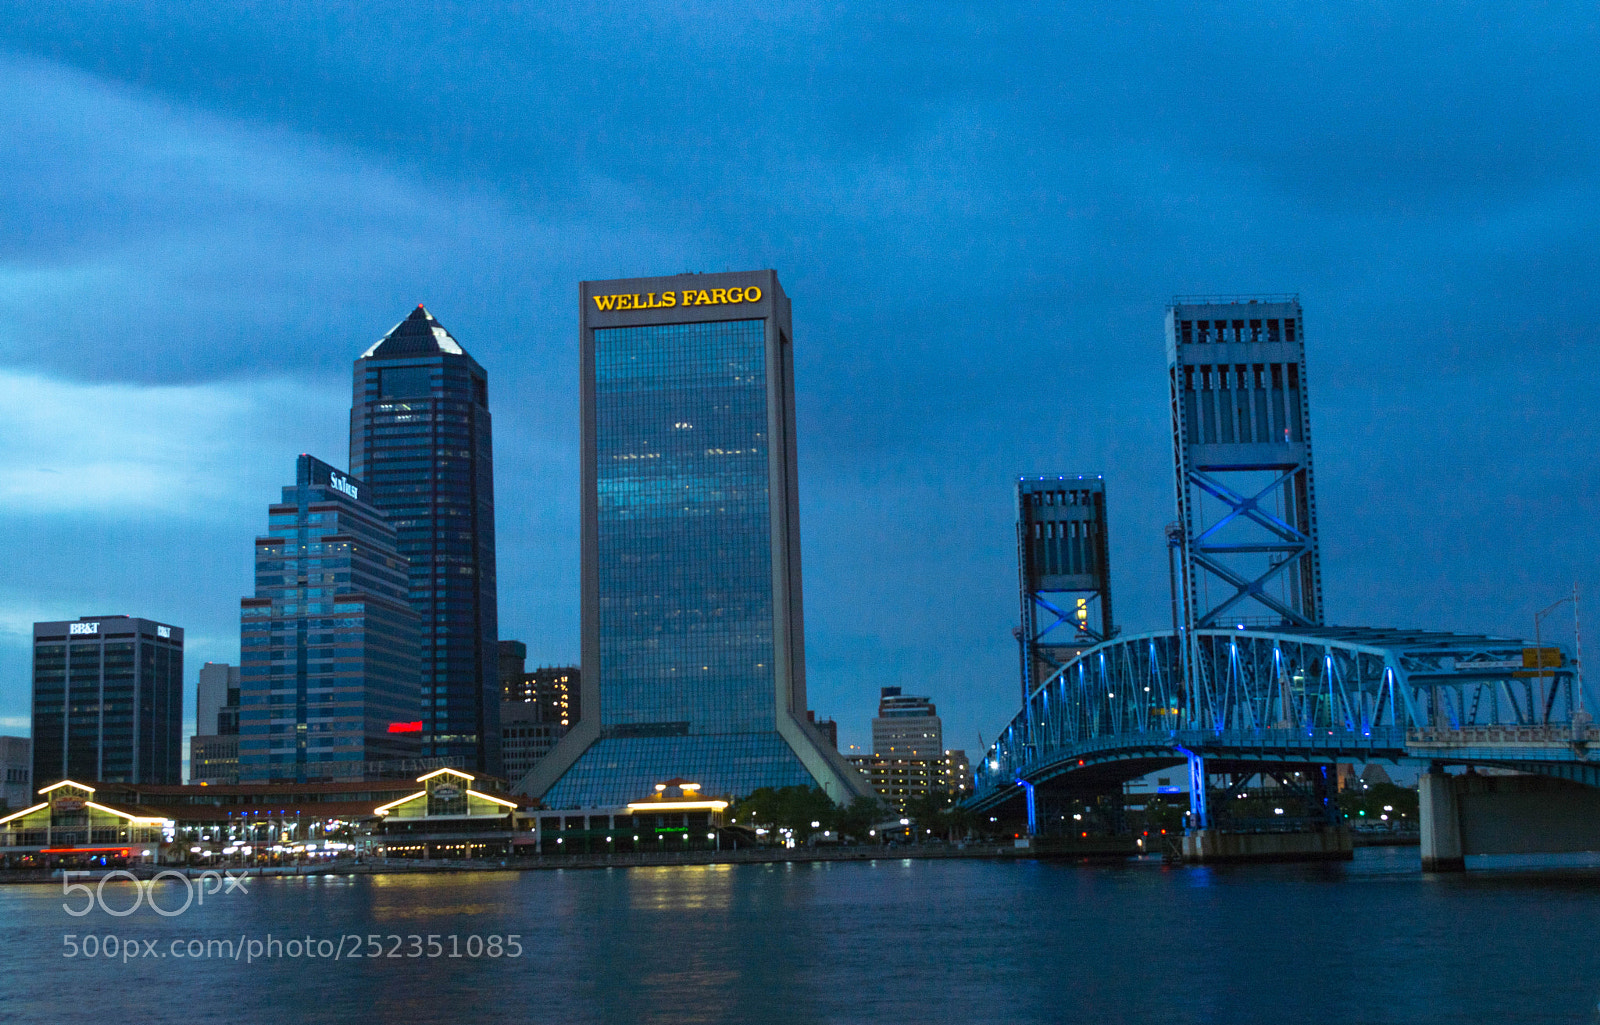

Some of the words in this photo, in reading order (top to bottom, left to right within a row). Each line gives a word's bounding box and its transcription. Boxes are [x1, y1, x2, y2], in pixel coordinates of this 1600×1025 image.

[593, 291, 676, 311] WELLS
[681, 286, 762, 306] FARGO
[69, 622, 100, 634] BB&T
